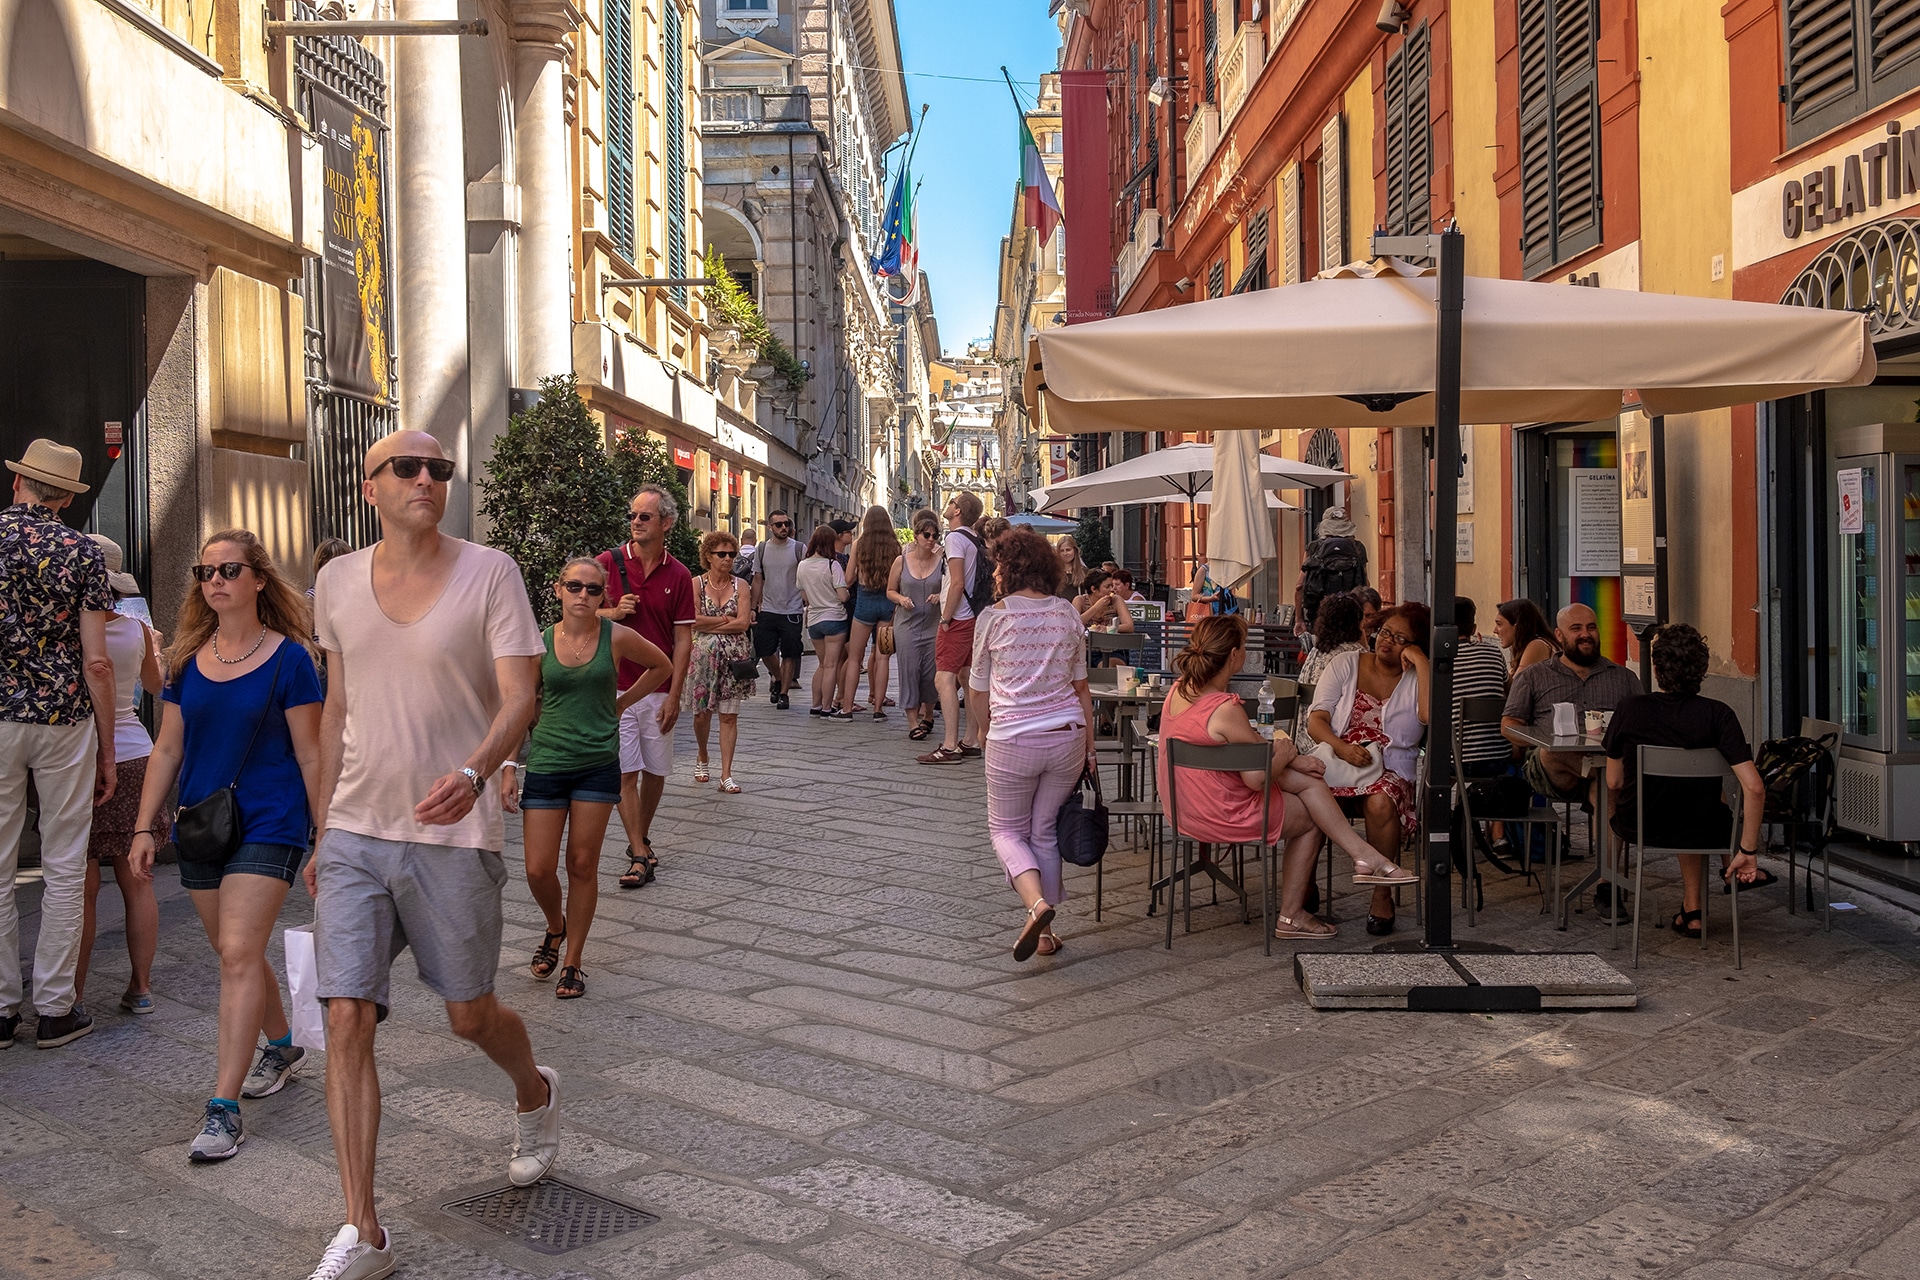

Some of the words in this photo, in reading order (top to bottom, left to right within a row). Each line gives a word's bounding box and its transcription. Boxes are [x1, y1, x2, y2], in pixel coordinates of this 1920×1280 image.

[323, 165, 353, 199] ORIEN
[333, 192, 354, 217] TALI
[333, 210, 355, 242] SMI
